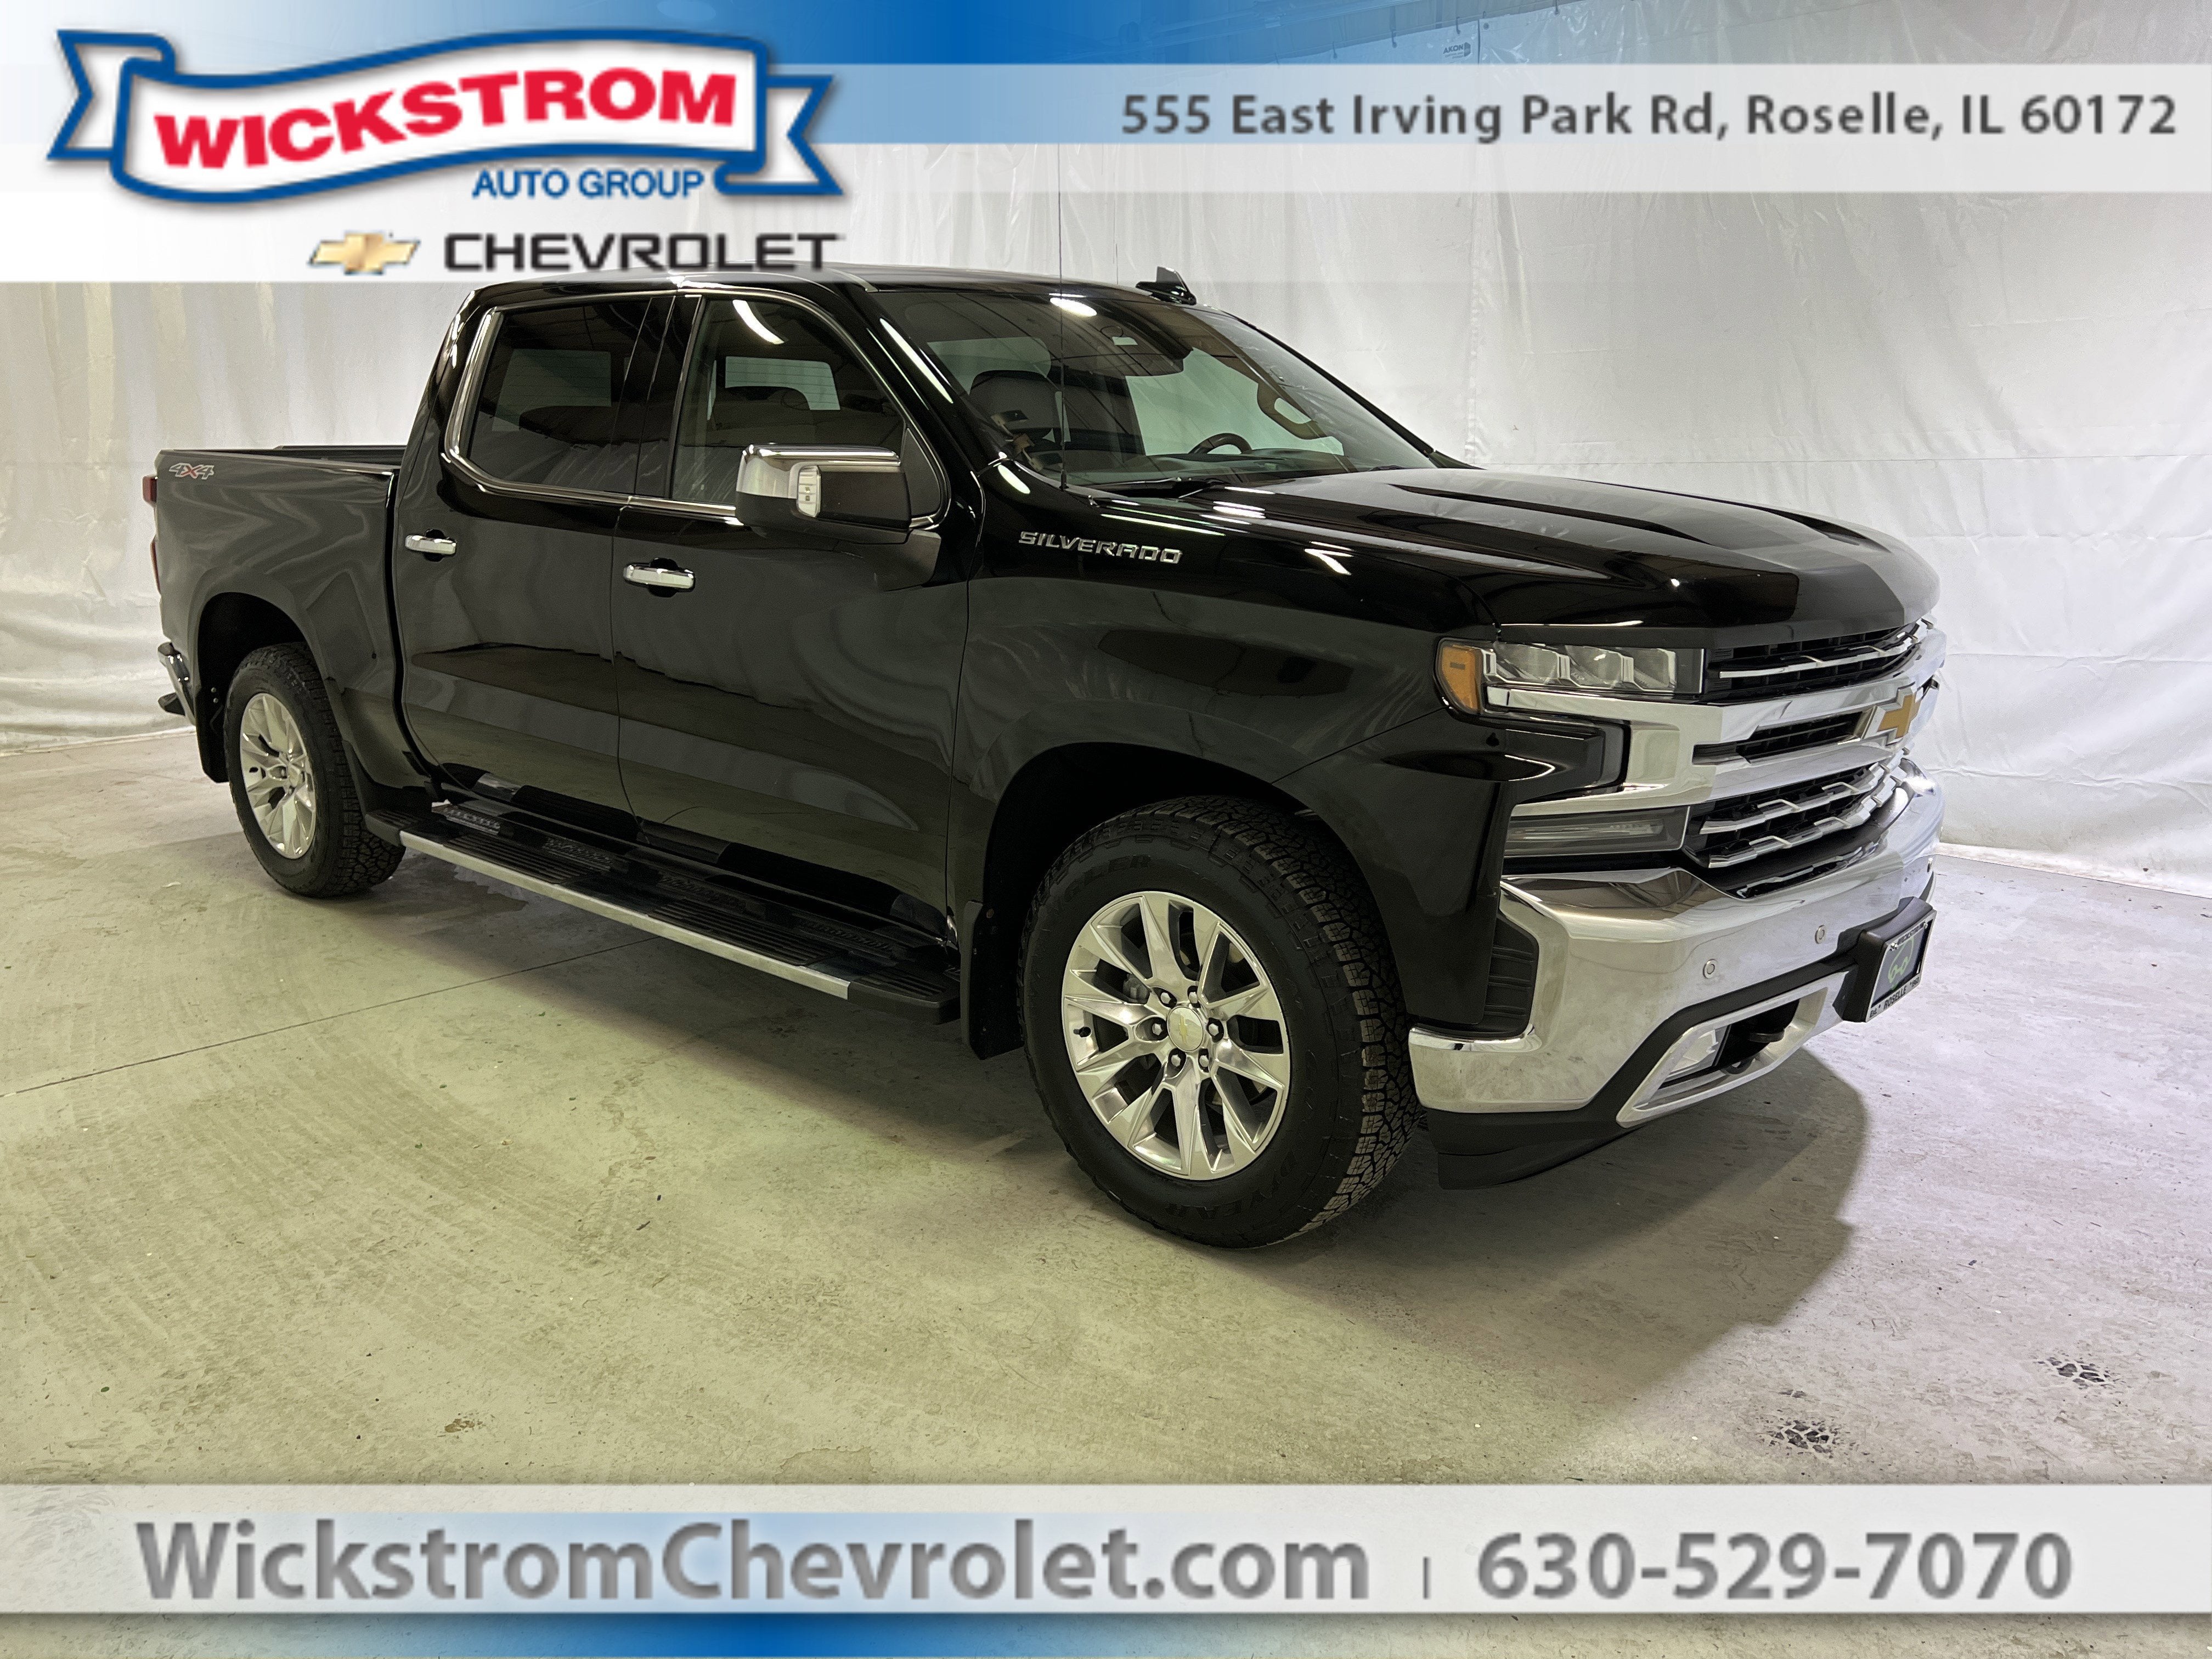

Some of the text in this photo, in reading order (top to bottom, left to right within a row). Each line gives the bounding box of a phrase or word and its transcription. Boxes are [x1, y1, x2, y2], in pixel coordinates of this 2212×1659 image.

[1443, 43, 1464, 54] AKON
[1018, 531, 1182, 564] SILVERADO
[1883, 985, 1908, 1010] ROSELLE
